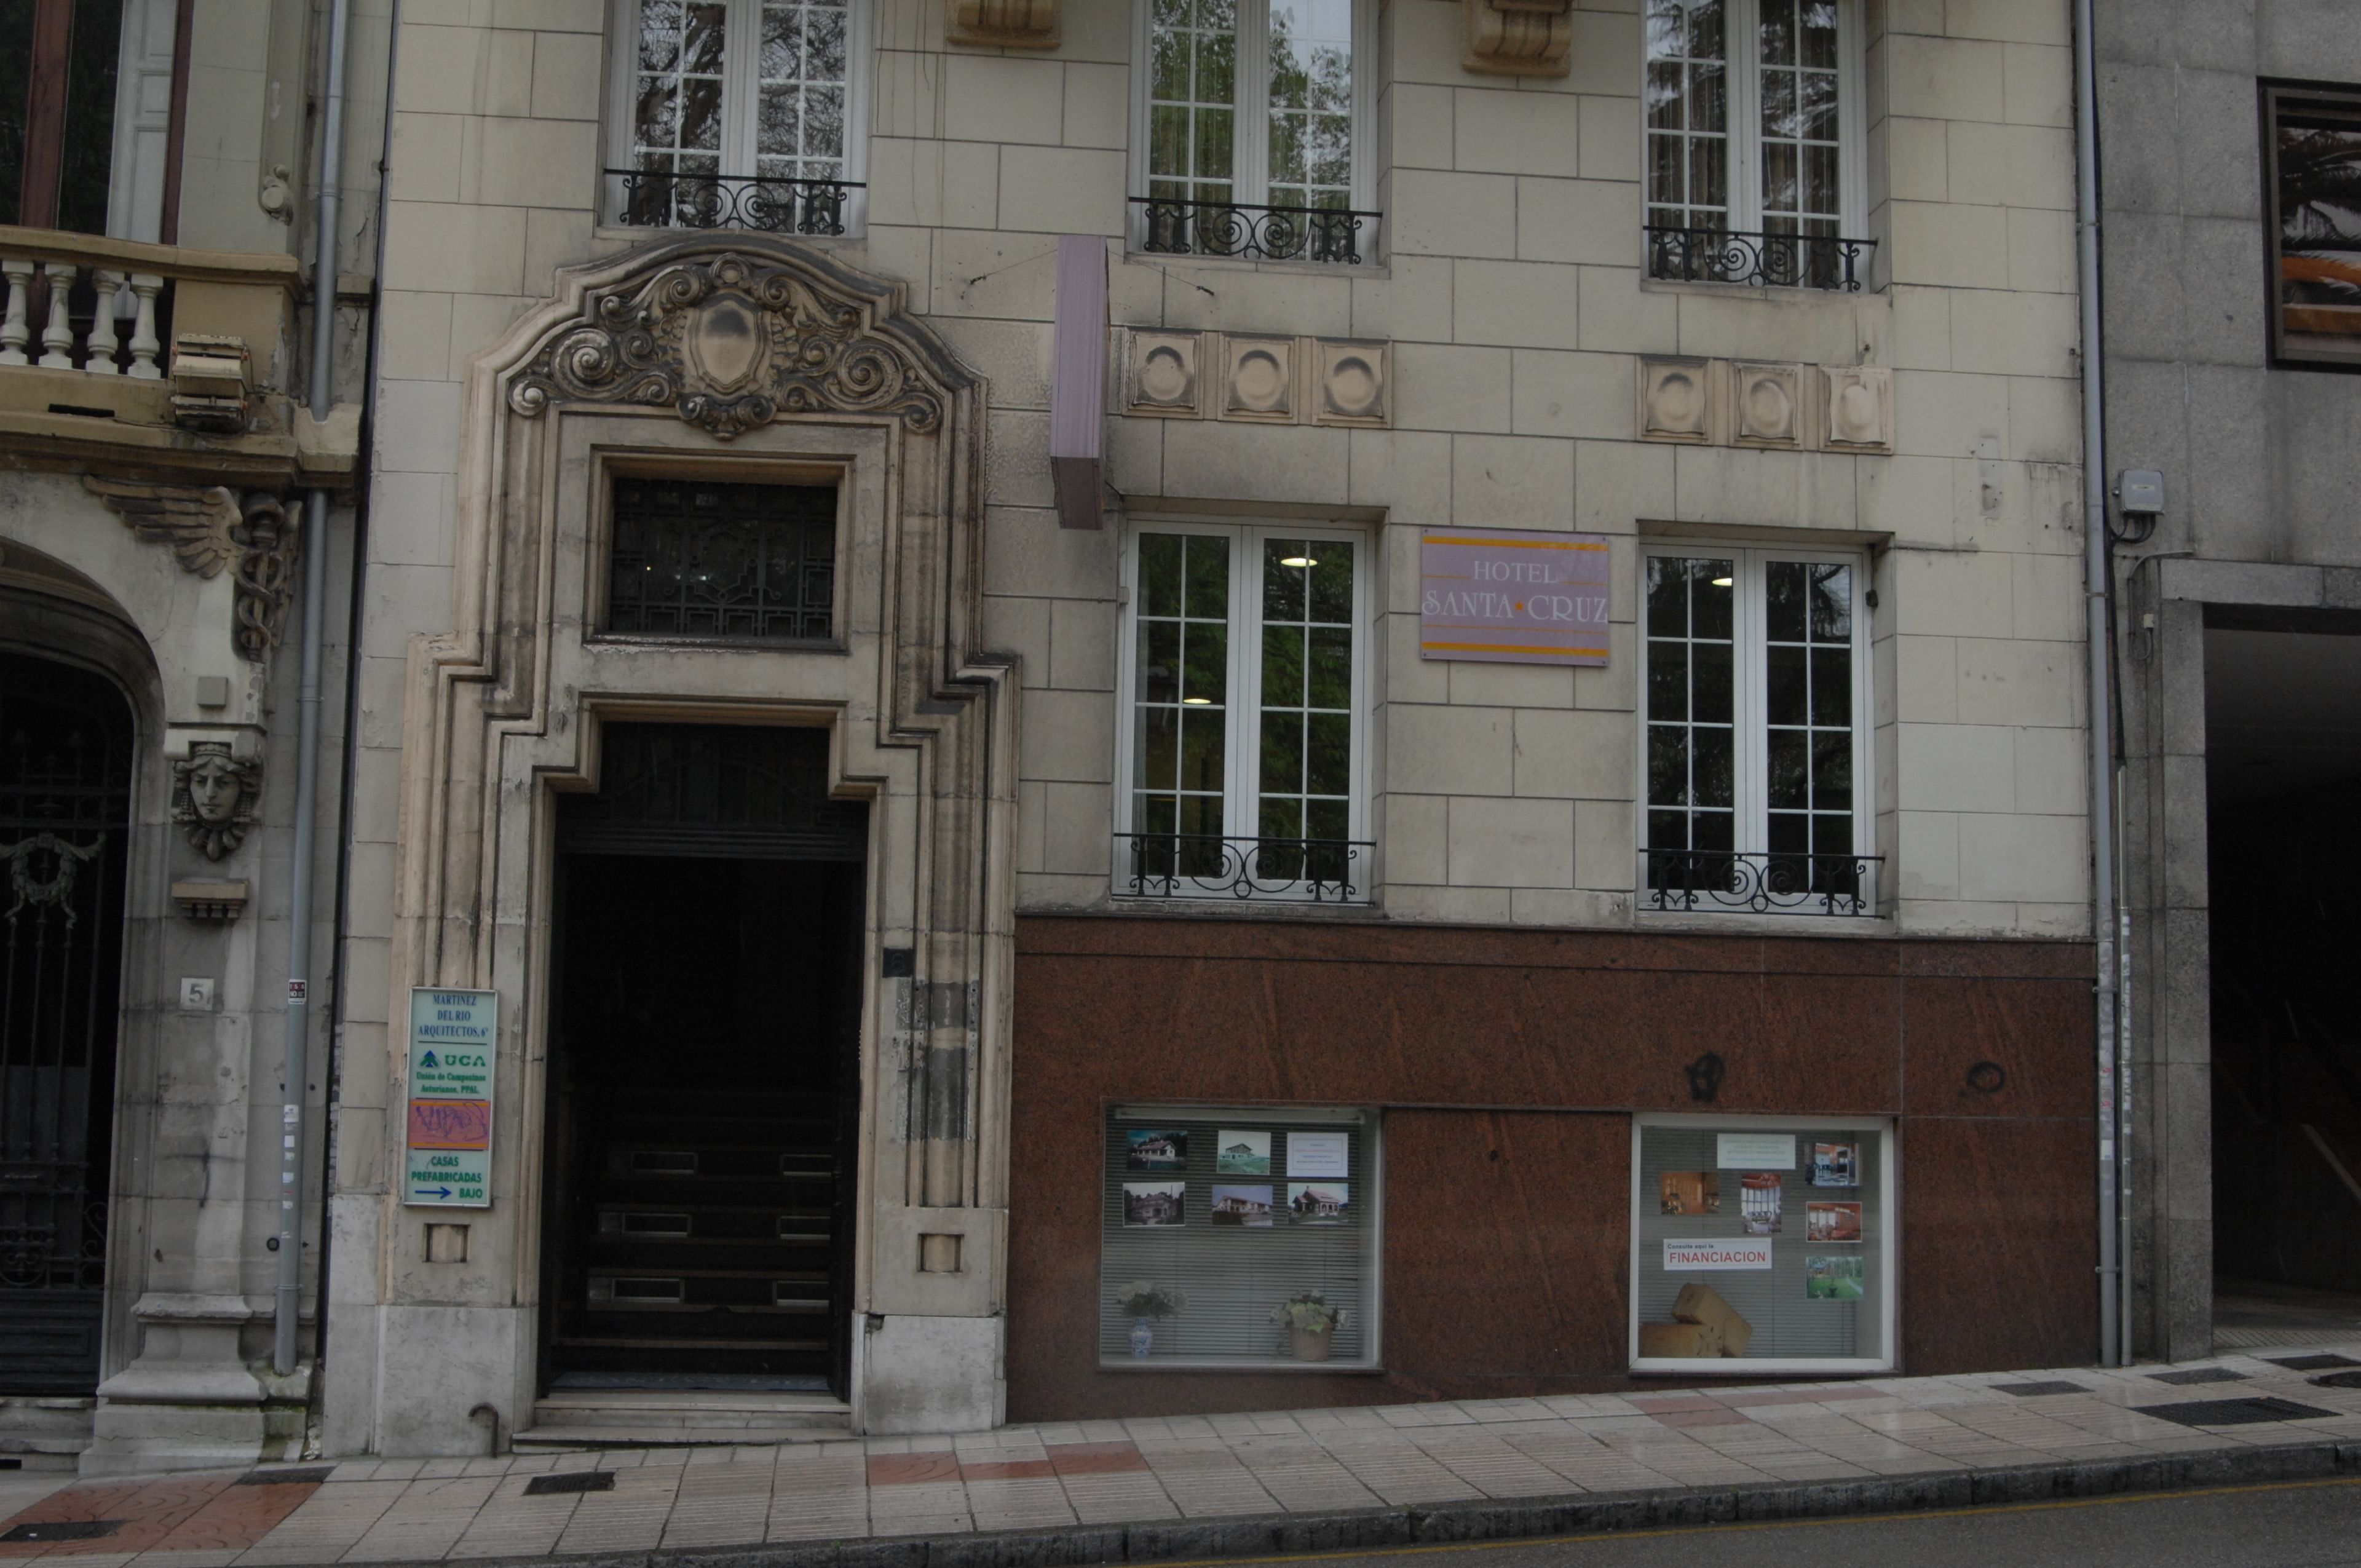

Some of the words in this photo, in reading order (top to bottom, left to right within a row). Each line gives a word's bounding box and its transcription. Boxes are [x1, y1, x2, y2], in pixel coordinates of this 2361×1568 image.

[1473, 561, 1559, 584] HOTEL
[1422, 590, 1514, 619] SANTA
[1528, 595, 1608, 625] CRUZ
[189, 983, 204, 1003] 5
[437, 1010, 454, 1021] DEL
[445, 1055, 486, 1067] UCA
[437, 1072, 445, 1080] de
[447, 1072, 486, 1083] Campesinos
[431, 1155, 459, 1167] CASAS
[411, 1171, 482, 1183] PREFABRICADAS
[459, 1188, 483, 1198] BAJO
[1669, 1251, 1766, 1264] FINANCIACION
